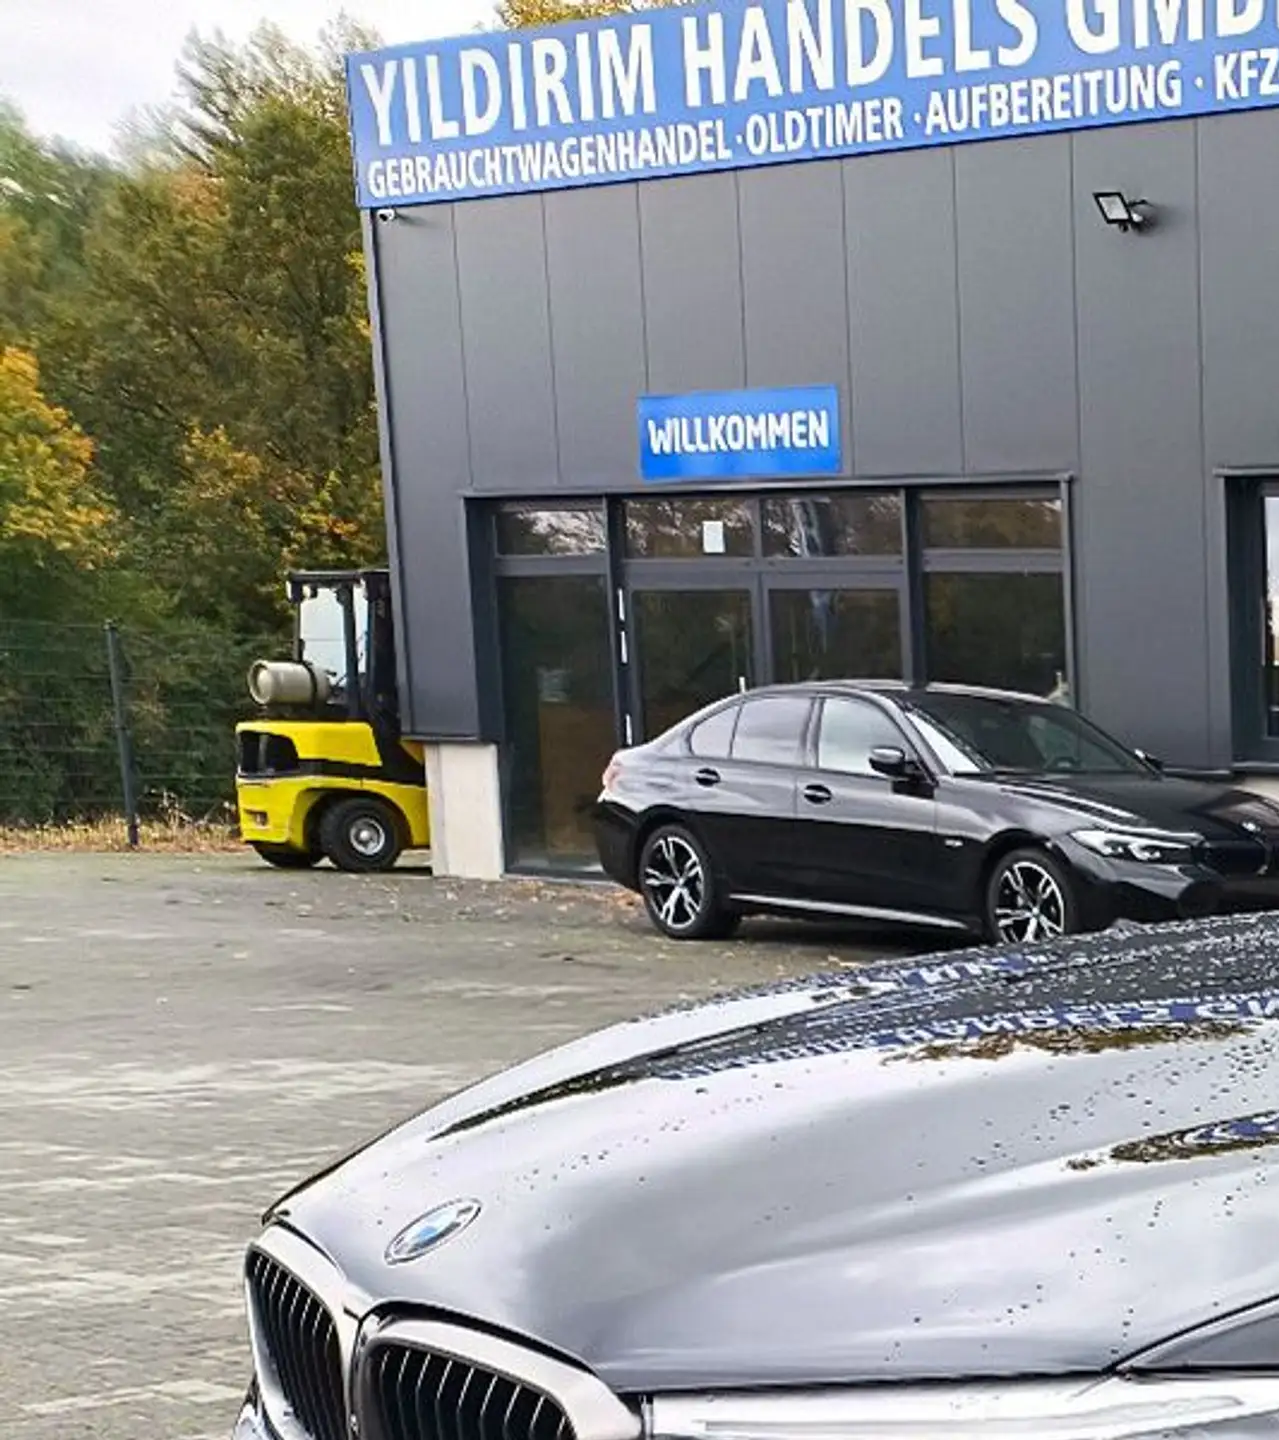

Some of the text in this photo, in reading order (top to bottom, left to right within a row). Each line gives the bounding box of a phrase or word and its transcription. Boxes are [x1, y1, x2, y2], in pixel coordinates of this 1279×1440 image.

[361, 25, 656, 147] YILDIRIM
[682, 0, 1039, 107] HANDELS
[368, 119, 731, 199] GEBRAUCHTWAGENHANDEL
[745, 98, 903, 155] OLDTIMER
[925, 60, 1182, 136] AUFBEREITUNG
[648, 410, 829, 454] WILLKOMMEN
